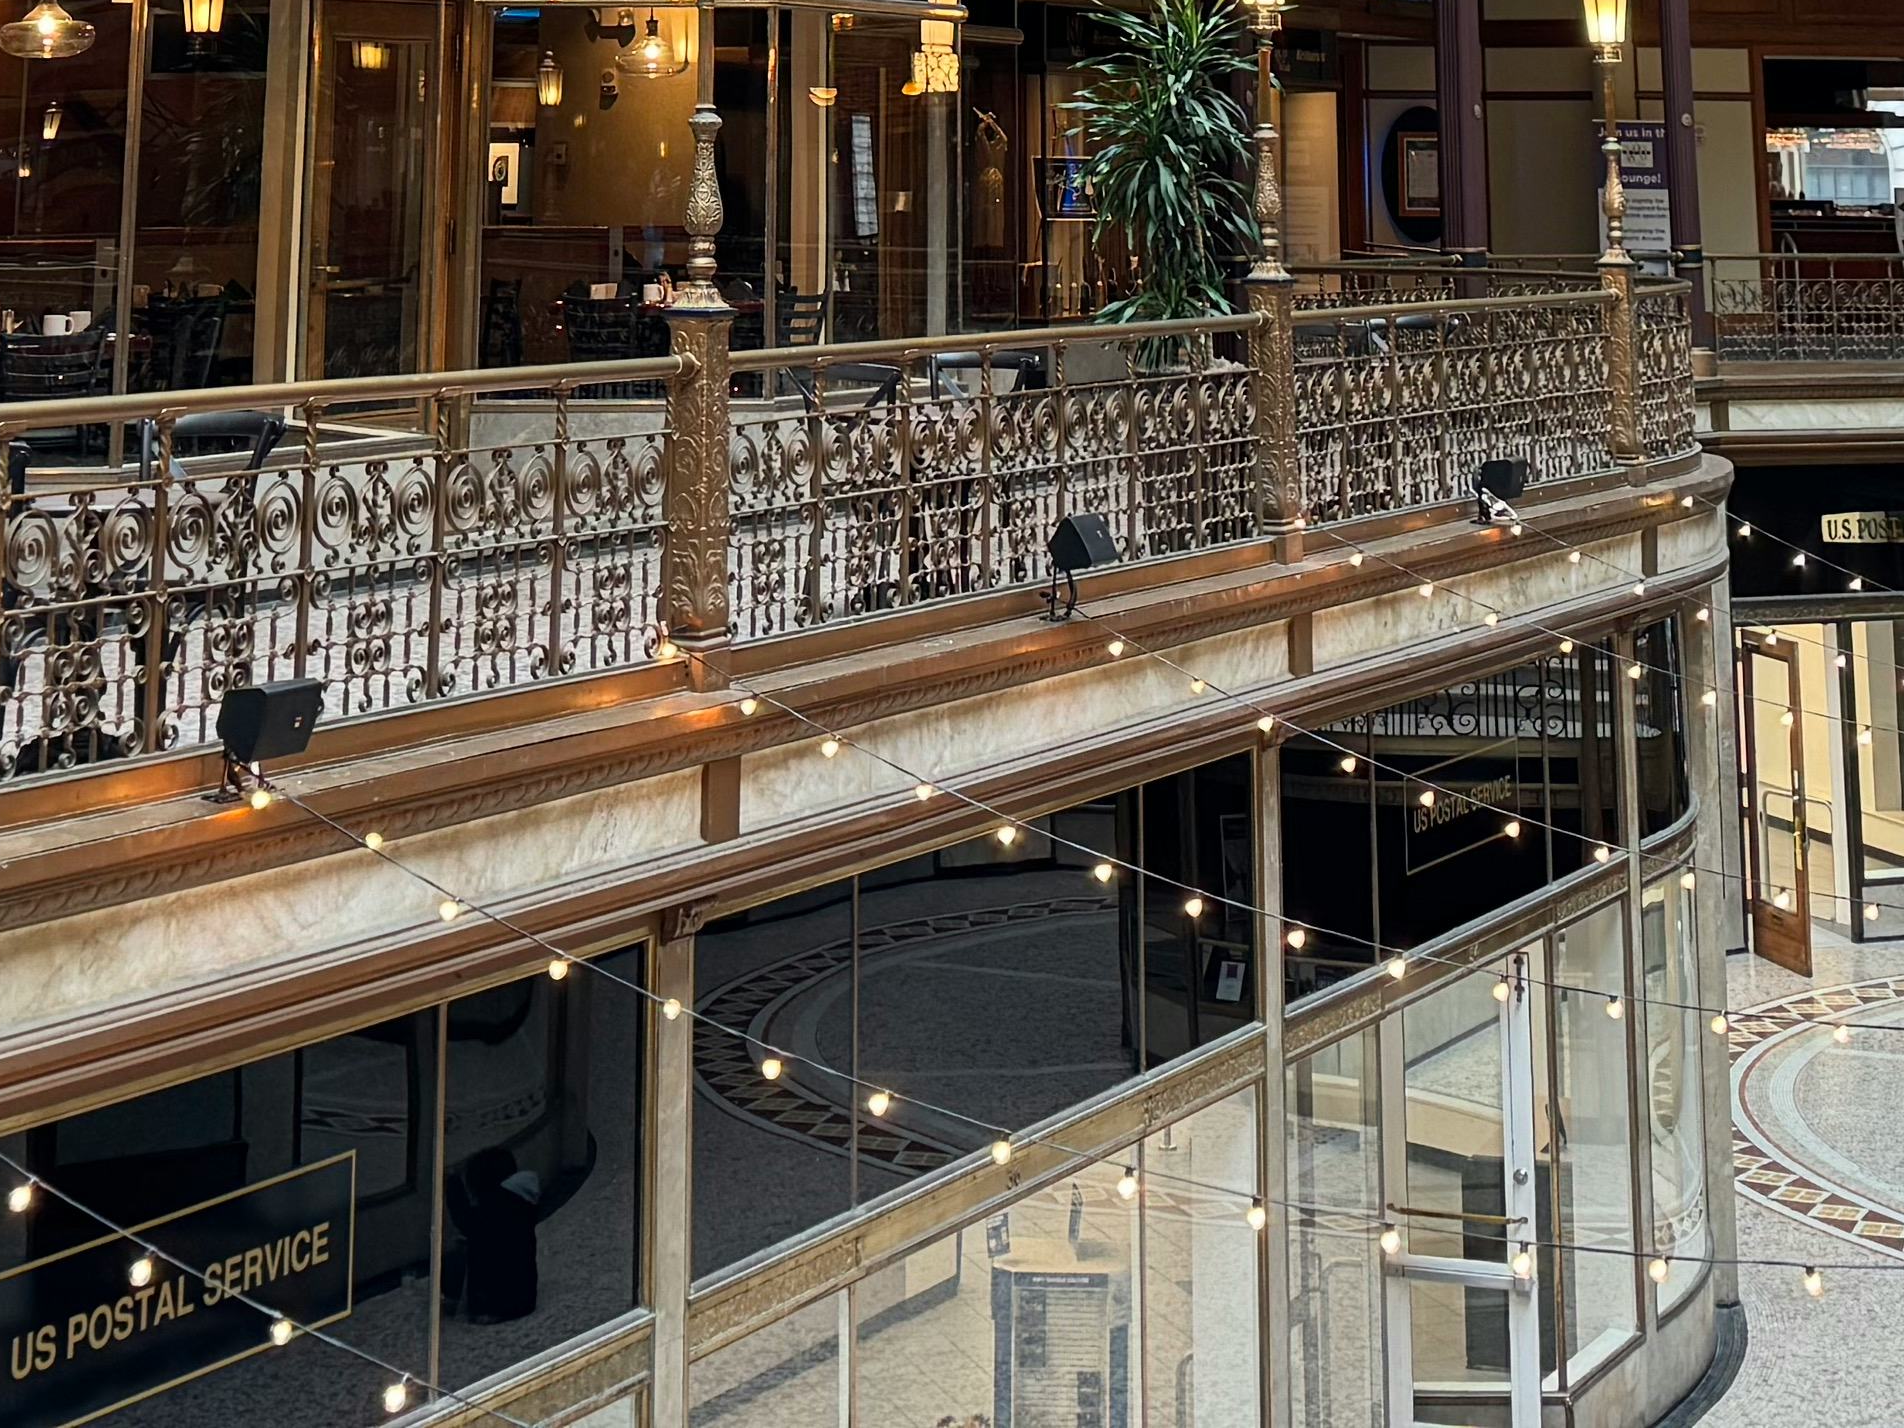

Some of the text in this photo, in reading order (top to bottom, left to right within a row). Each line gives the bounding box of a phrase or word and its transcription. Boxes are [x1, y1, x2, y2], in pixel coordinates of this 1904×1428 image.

[1626, 128, 1639, 137] us
[1621, 174, 1661, 184] ounge!
[1826, 517, 1856, 541] U.S.
[1856, 517, 1900, 540] POST
[1413, 775, 1512, 833] US POSTAL SERVICE
[10, 1221, 331, 1381] US POSTAL SERVICE
